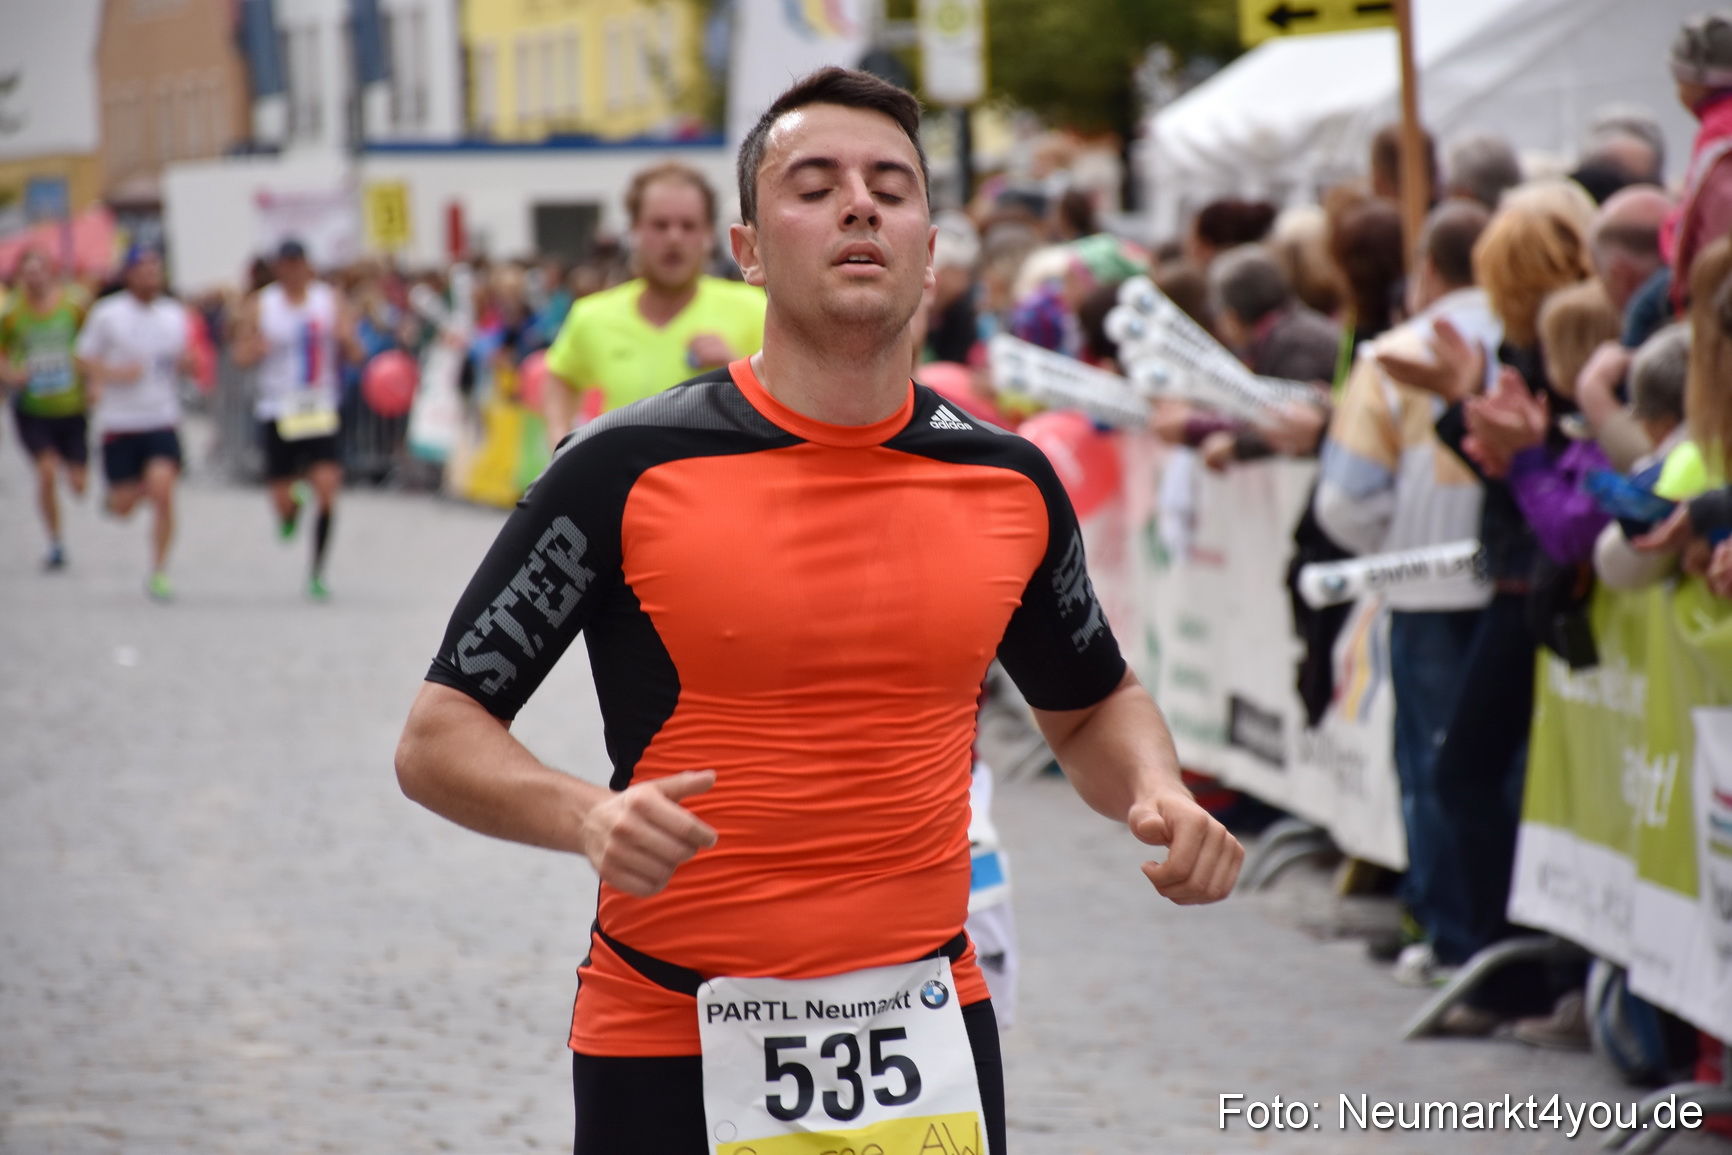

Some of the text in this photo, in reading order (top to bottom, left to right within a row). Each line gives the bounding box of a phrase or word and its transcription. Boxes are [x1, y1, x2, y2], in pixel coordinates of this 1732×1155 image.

[929, 420, 974, 431] adidas
[450, 515, 597, 696] STEP
[707, 990, 911, 1024] PARTL Neumarkt
[764, 1026, 922, 1122] 535
